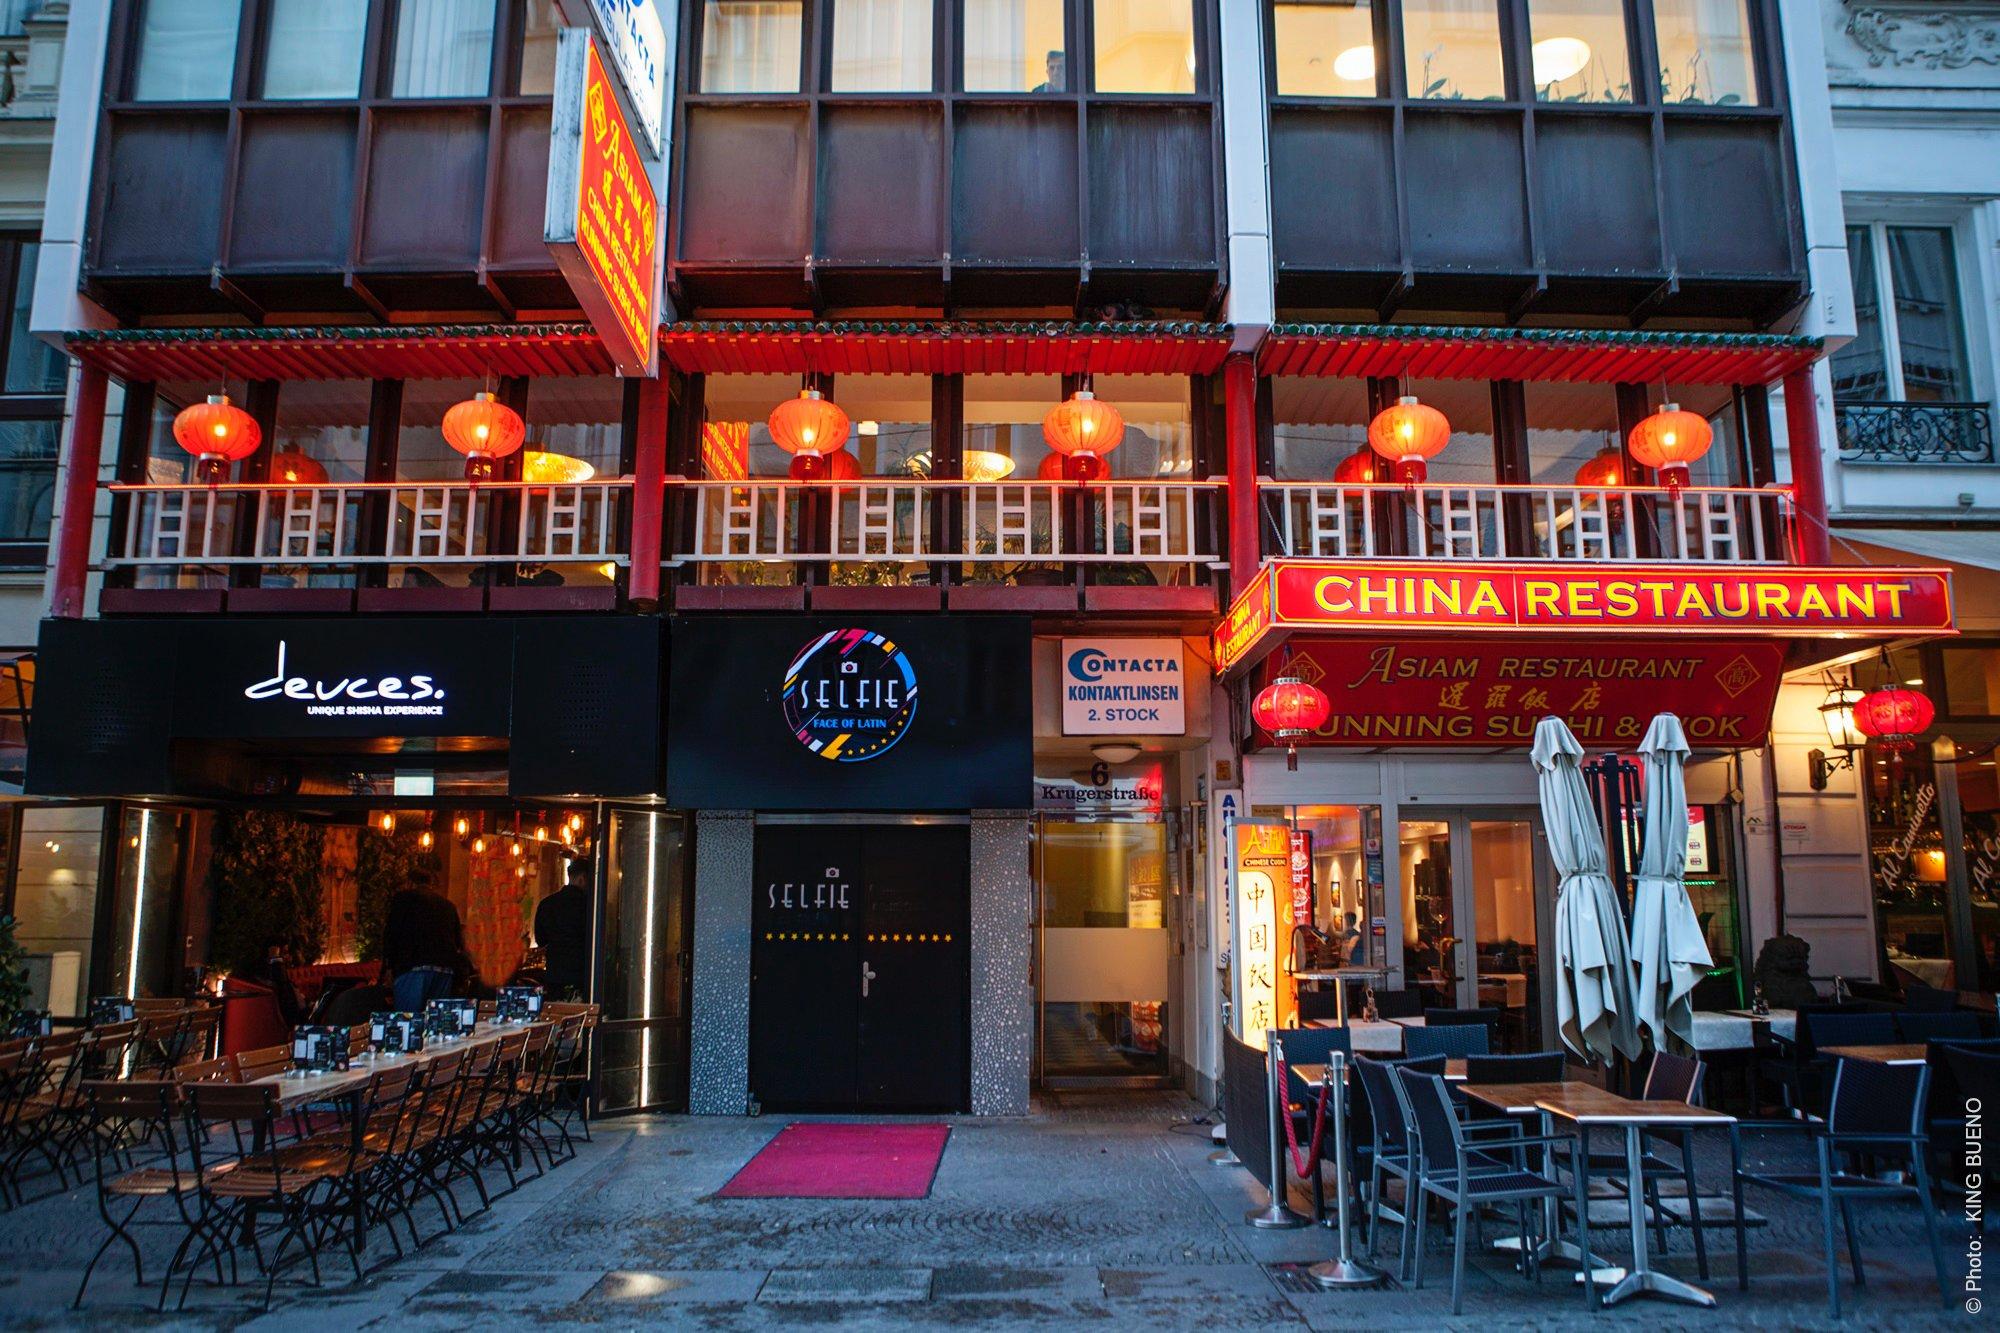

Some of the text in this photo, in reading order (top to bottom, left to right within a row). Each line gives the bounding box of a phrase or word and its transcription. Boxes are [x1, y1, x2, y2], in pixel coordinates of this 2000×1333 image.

[587, 186, 648, 316] CHINA RESTAURANT
[580, 209, 613, 284] RUNNING
[612, 272, 632, 319] SUSHI
[635, 318, 648, 352] WOK
[1314, 574, 1914, 619] CHINA RESTAURANT
[1231, 598, 1251, 633] CHINA
[1067, 647, 1179, 683] CONTACTA
[1348, 646, 1480, 688] ASIAM
[1498, 657, 1704, 680] RESTAURANT
[800, 679, 899, 709] SELFIE
[1068, 685, 1179, 701] KONTAKTLINSEN
[307, 705, 444, 716] UNIQUE SHISHA EXPERIENCE
[813, 718, 887, 729] FACE OF LATIN
[1088, 708, 1160, 722] 2. STOCK
[1314, 714, 1745, 738] UNNING SUHI & OK
[1090, 761, 1109, 787] 6
[1041, 785, 1159, 803] Krugerstraße
[768, 883, 850, 909] SELFIE
